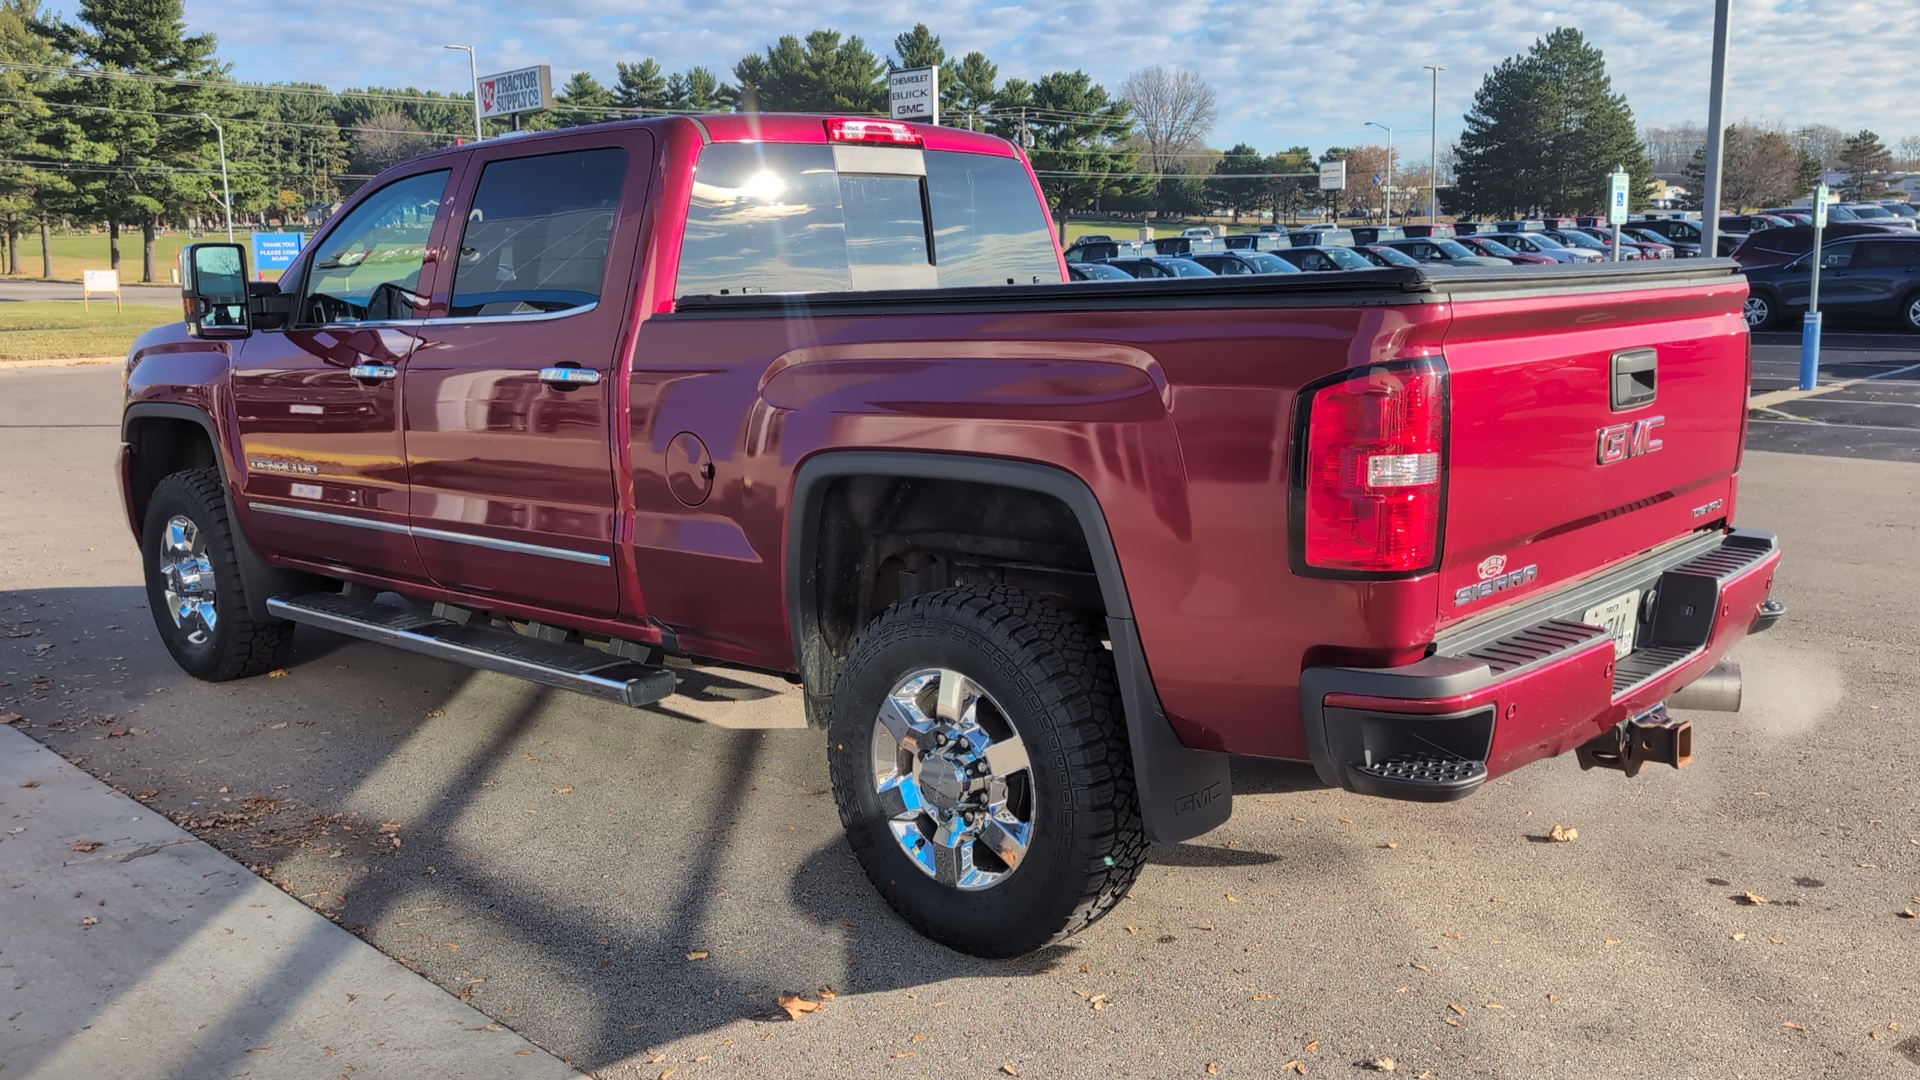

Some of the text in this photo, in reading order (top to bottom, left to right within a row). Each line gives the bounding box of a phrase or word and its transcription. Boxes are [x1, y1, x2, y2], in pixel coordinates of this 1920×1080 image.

[495, 70, 538, 94] TRACTOR
[892, 74, 929, 86] CHEVROLET
[481, 83, 494, 106] TSC
[496, 90, 528, 112] SUPPLY
[892, 88, 929, 101] BUICK
[897, 103, 924, 115] GMC
[1596, 415, 1666, 467] GMC
[251, 459, 297, 474] DENALI
[1454, 564, 1538, 607] SIERRA
[1175, 781, 1221, 816] GMC
